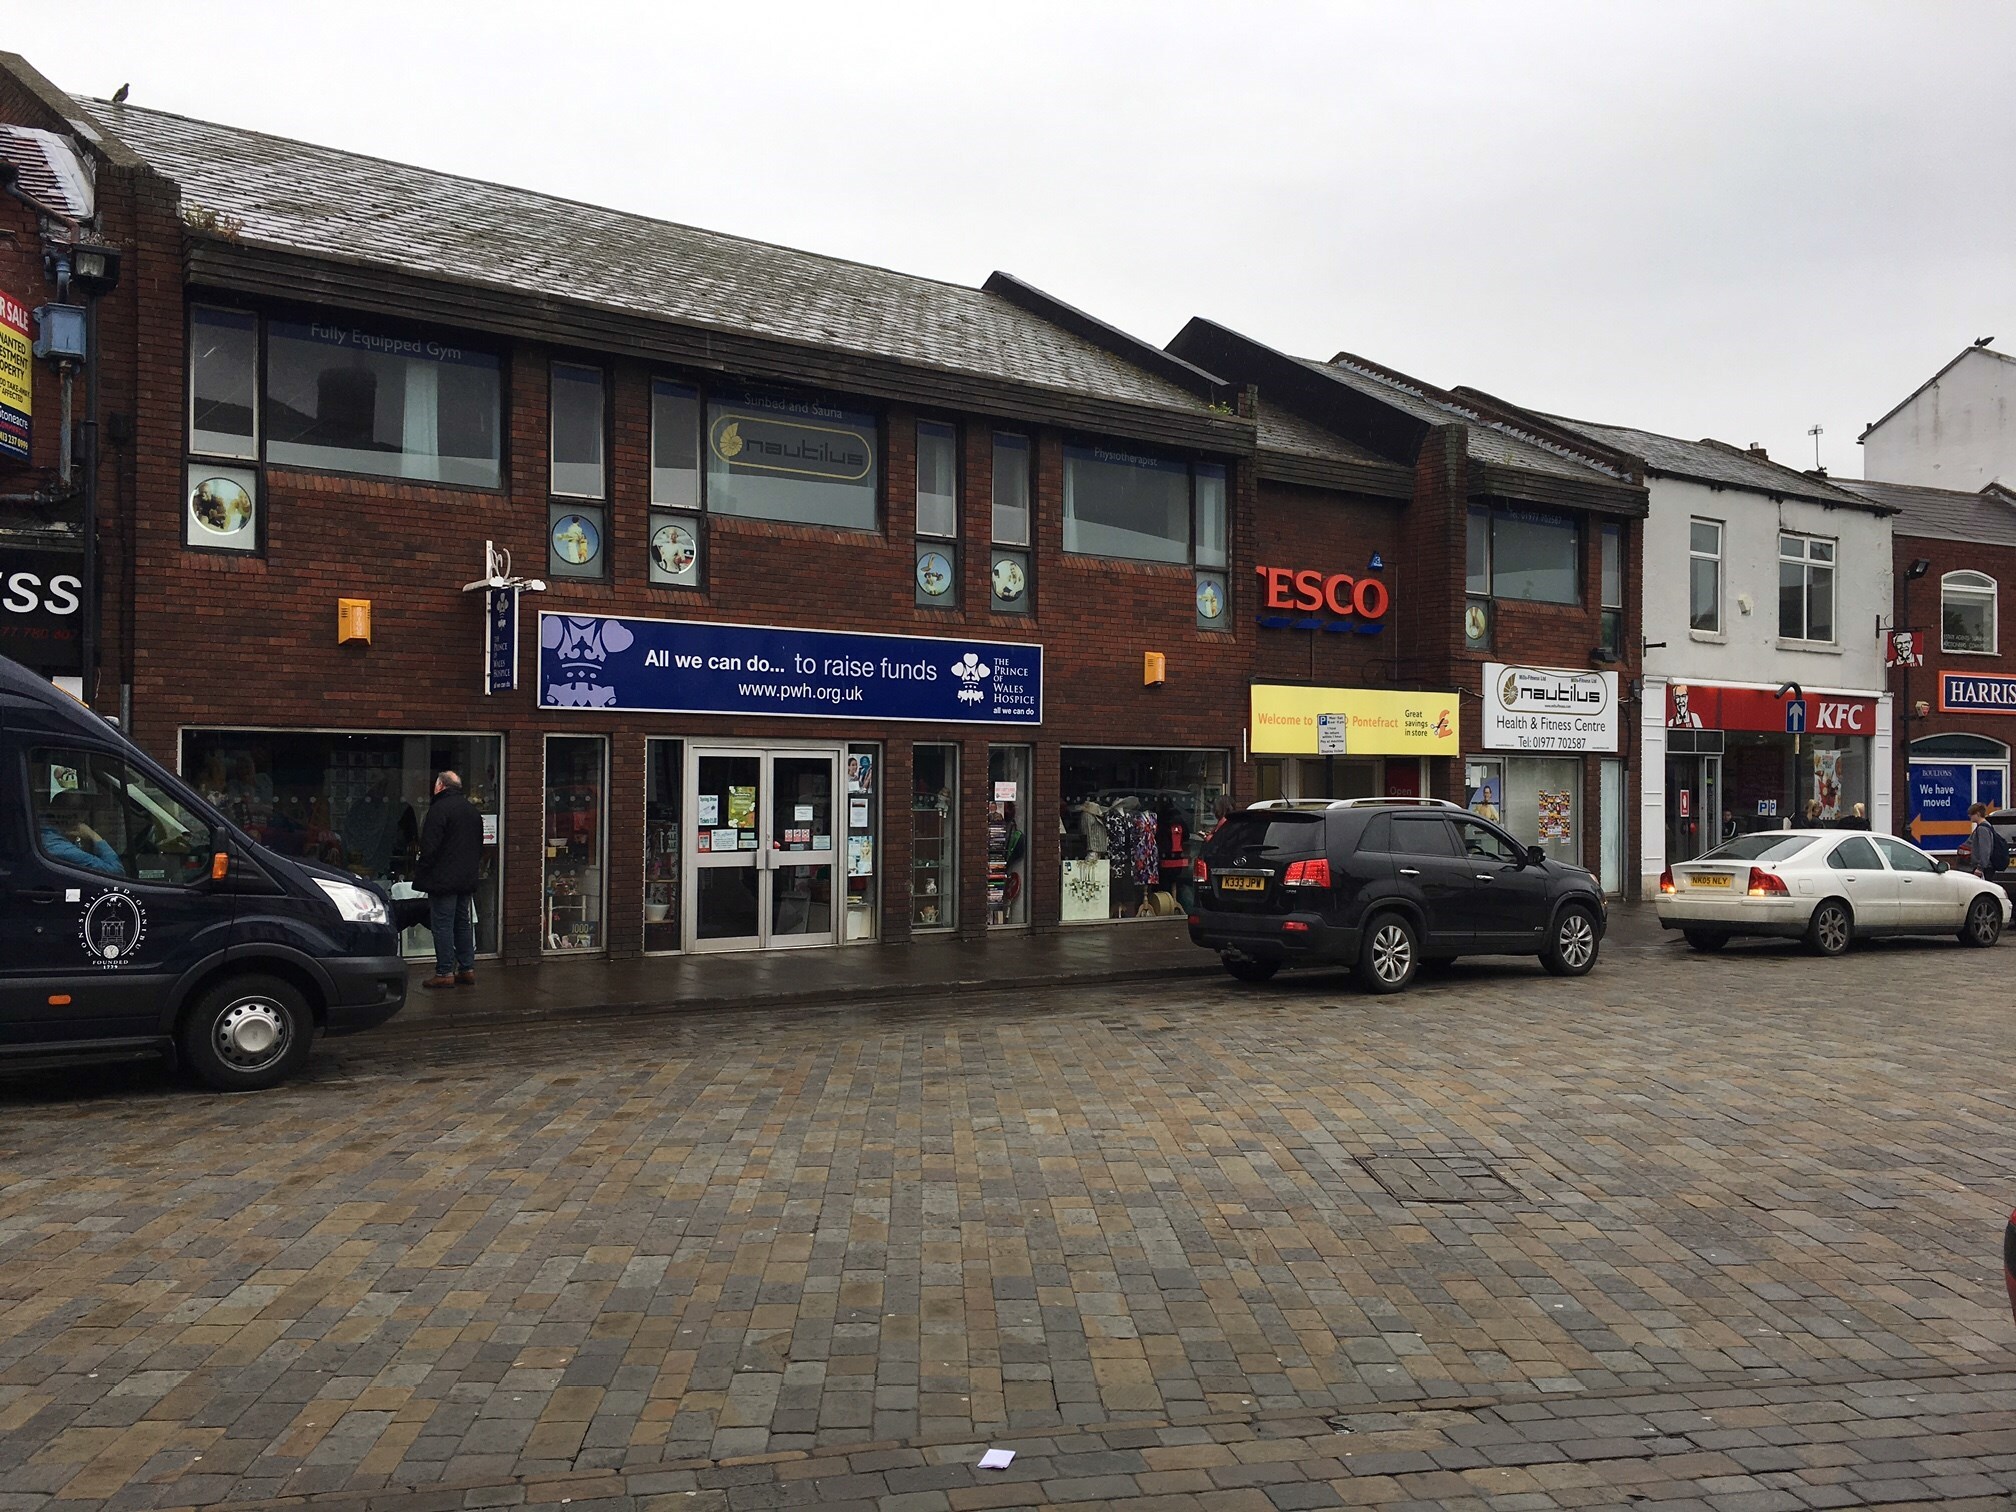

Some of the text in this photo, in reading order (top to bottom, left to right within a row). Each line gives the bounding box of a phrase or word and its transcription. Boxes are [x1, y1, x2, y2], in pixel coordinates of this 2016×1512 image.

[7, 301, 28, 332] SALE
[311, 323, 461, 360] Fully Equipped Gym
[744, 392, 842, 419] Sunbed and Sauna
[746, 439, 863, 466] nautilus
[1094, 447, 1158, 467] Physiotherapist
[1256, 566, 1389, 618] ESCO
[644, 650, 938, 681] All we can do... to raise funds
[994, 666, 1028, 676] PRINCE
[738, 683, 863, 704] www.pwh.org.uk
[993, 683, 1024, 693] WALES
[1520, 682, 1600, 703] nautilus
[994, 694, 1034, 704] HOSPICE
[1258, 713, 1313, 726] Welcome to
[1405, 709, 1423, 718] Great
[1816, 702, 1864, 730] KFC
[1321, 717, 1326, 725] P
[1352, 718, 1399, 728] Pontefract
[1405, 720, 1428, 729] savings
[1496, 715, 1606, 732] Health & Fitness Centre
[1518, 736, 1586, 749] Tel: 01977 702587
[1390, 786, 1412, 796] Open
[1920, 784, 1954, 794] We have
[1760, 803, 1767, 812] P
[1771, 803, 1775, 812] P
[1923, 796, 1951, 807] moved
[1225, 876, 1244, 887] K333
